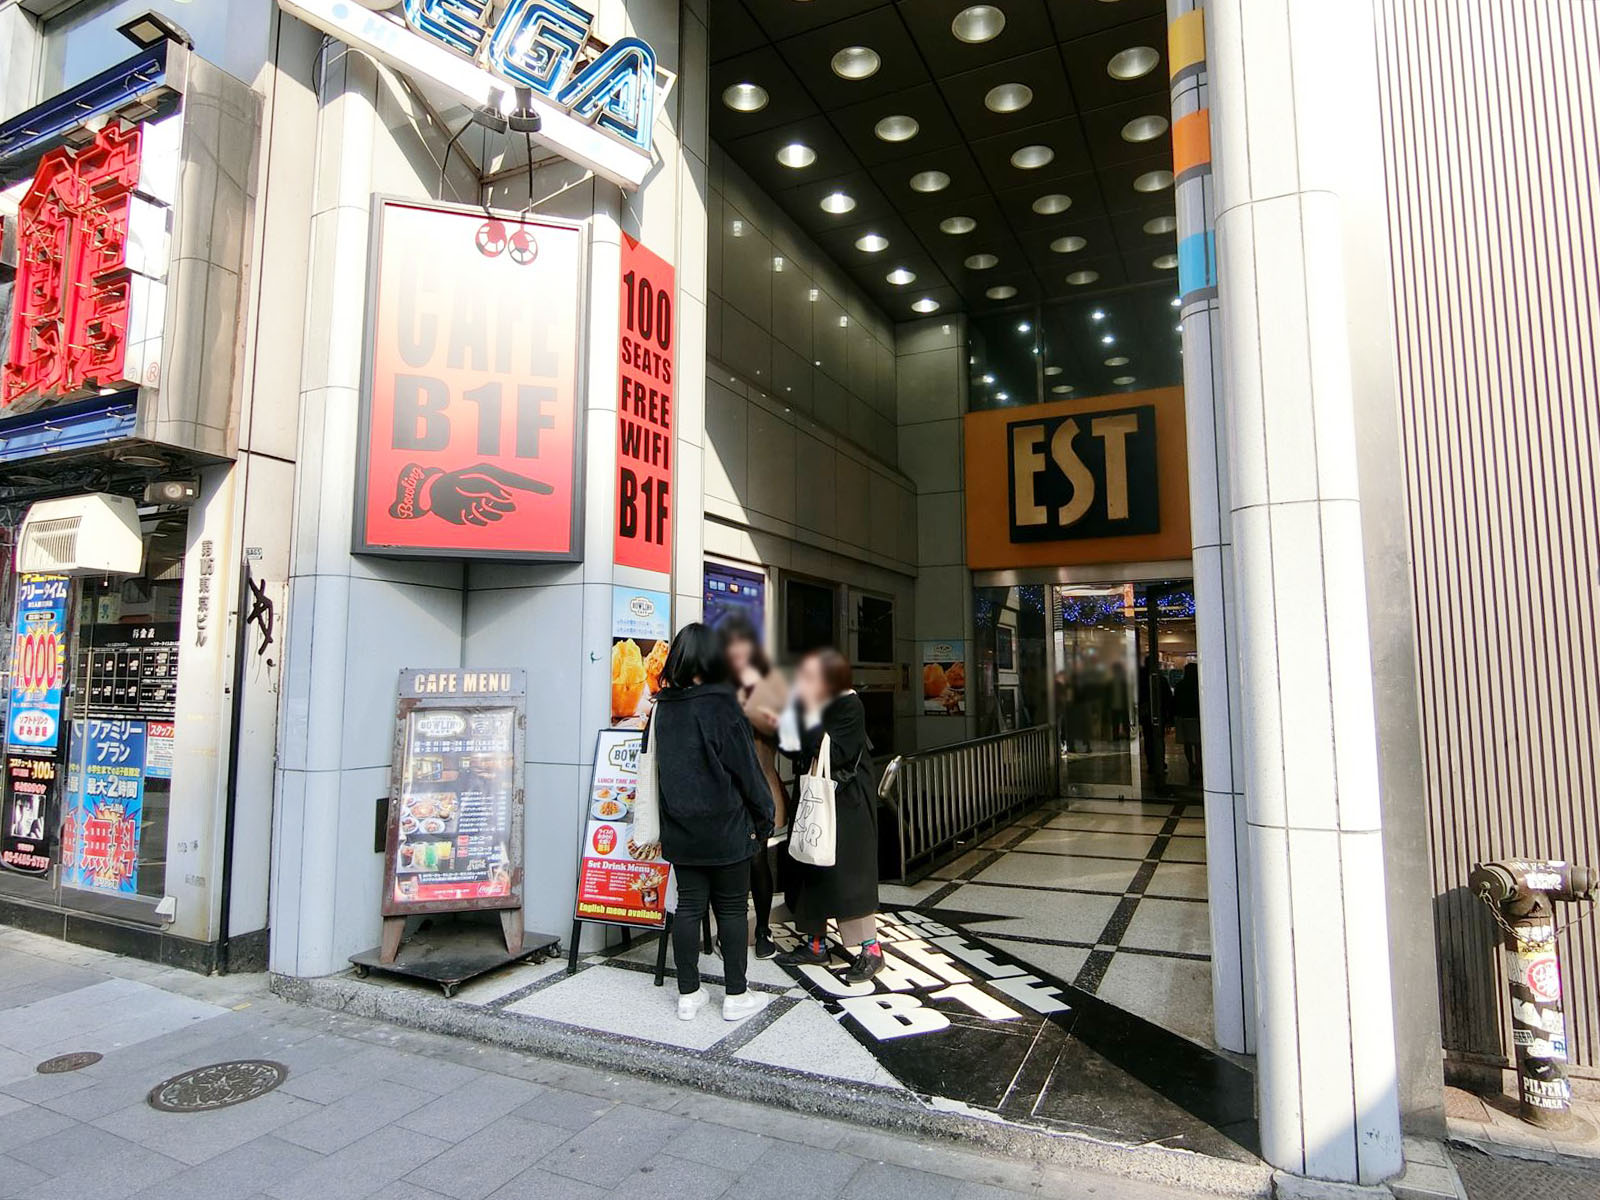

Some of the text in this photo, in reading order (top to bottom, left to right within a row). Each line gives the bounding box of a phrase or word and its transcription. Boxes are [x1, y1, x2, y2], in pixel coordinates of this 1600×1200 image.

[403, 0, 656, 151] EGA
[397, 258, 559, 378] CAFE
[624, 270, 671, 351] 100
[622, 336, 671, 385] SEATS
[391, 373, 557, 459] B1F
[622, 375, 670, 429] FREE
[620, 418, 669, 470] WIFI
[1012, 413, 1139, 527] EST
[398, 464, 425, 519] Bowling
[620, 466, 669, 546] B1F
[21, 582, 67, 600] フリータイム
[414, 673, 512, 693] CAFE MENU
[90, 721, 143, 740] ファミリー
[96, 742, 131, 763] プラン
[614, 749, 641, 762] BOW
[87, 775, 139, 799] 最大2時間
[80, 814, 137, 877] 無料
[587, 860, 650, 873] Set Drink Menu
[579, 902, 662, 920] English menu available
[836, 974, 1073, 1043] B1F
